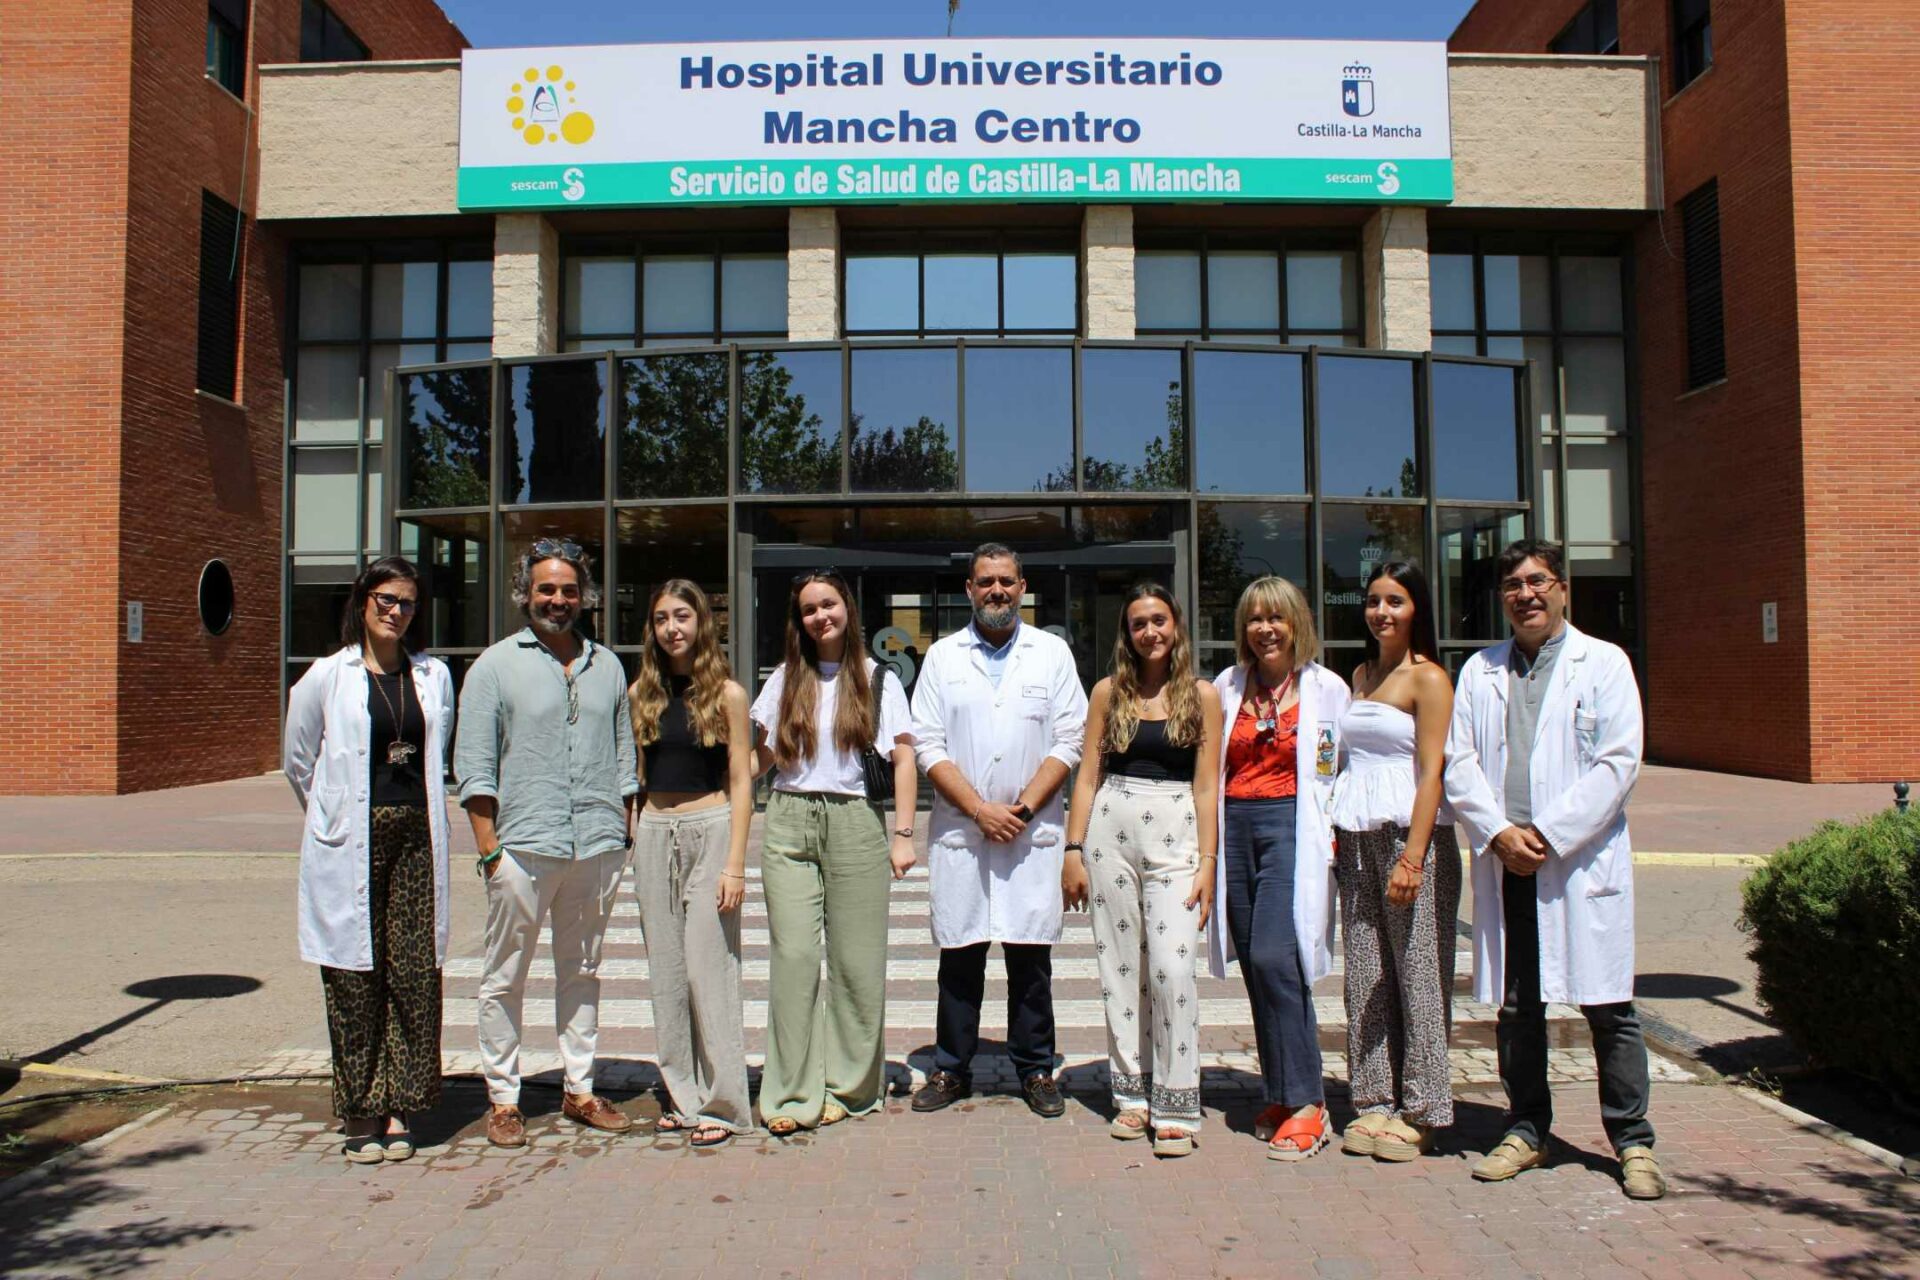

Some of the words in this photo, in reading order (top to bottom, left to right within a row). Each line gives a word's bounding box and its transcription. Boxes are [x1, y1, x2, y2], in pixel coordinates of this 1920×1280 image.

[680, 54, 884, 95] Hospital
[903, 51, 1223, 86] Universitario
[763, 109, 957, 144] Mancha
[974, 108, 1141, 144] Centro
[1297, 122, 1367, 138] Castilla-La
[1372, 124, 1422, 139] Mancha
[511, 180, 558, 191] sescam
[669, 165, 786, 197] Servicio
[794, 166, 828, 195] de
[837, 164, 917, 195] Salud
[925, 164, 960, 194] de
[968, 162, 1121, 194] Castilla-La
[1130, 162, 1241, 193] Mancha
[1325, 171, 1373, 184] sescam
[1324, 592, 1366, 605] Castilla-
